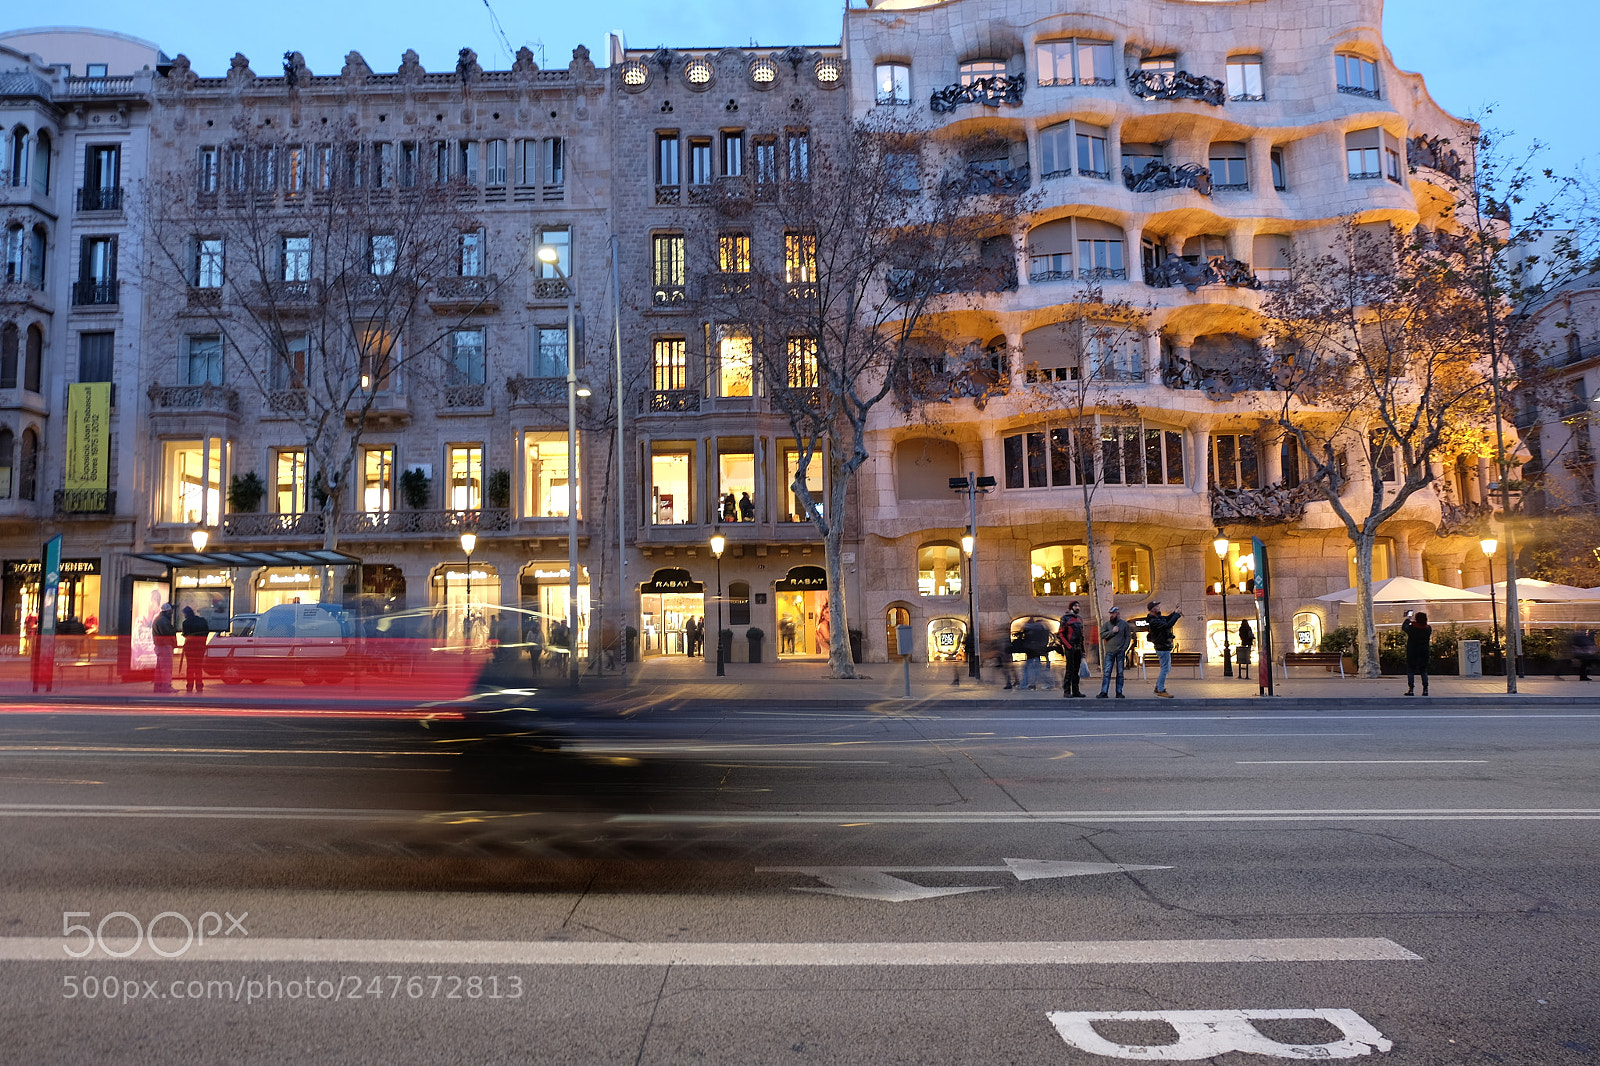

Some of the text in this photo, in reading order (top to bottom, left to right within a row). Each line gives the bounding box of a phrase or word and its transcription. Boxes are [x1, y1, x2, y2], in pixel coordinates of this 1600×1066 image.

[91, 414, 100, 433] 2012
[83, 424, 91, 443] Joan
[91, 438, 99, 456] 1975
[90, 457, 99, 481] Obres
[59, 562, 95, 572] VENETA
[655, 580, 690, 588] RABAT
[790, 577, 824, 586] RABAT
